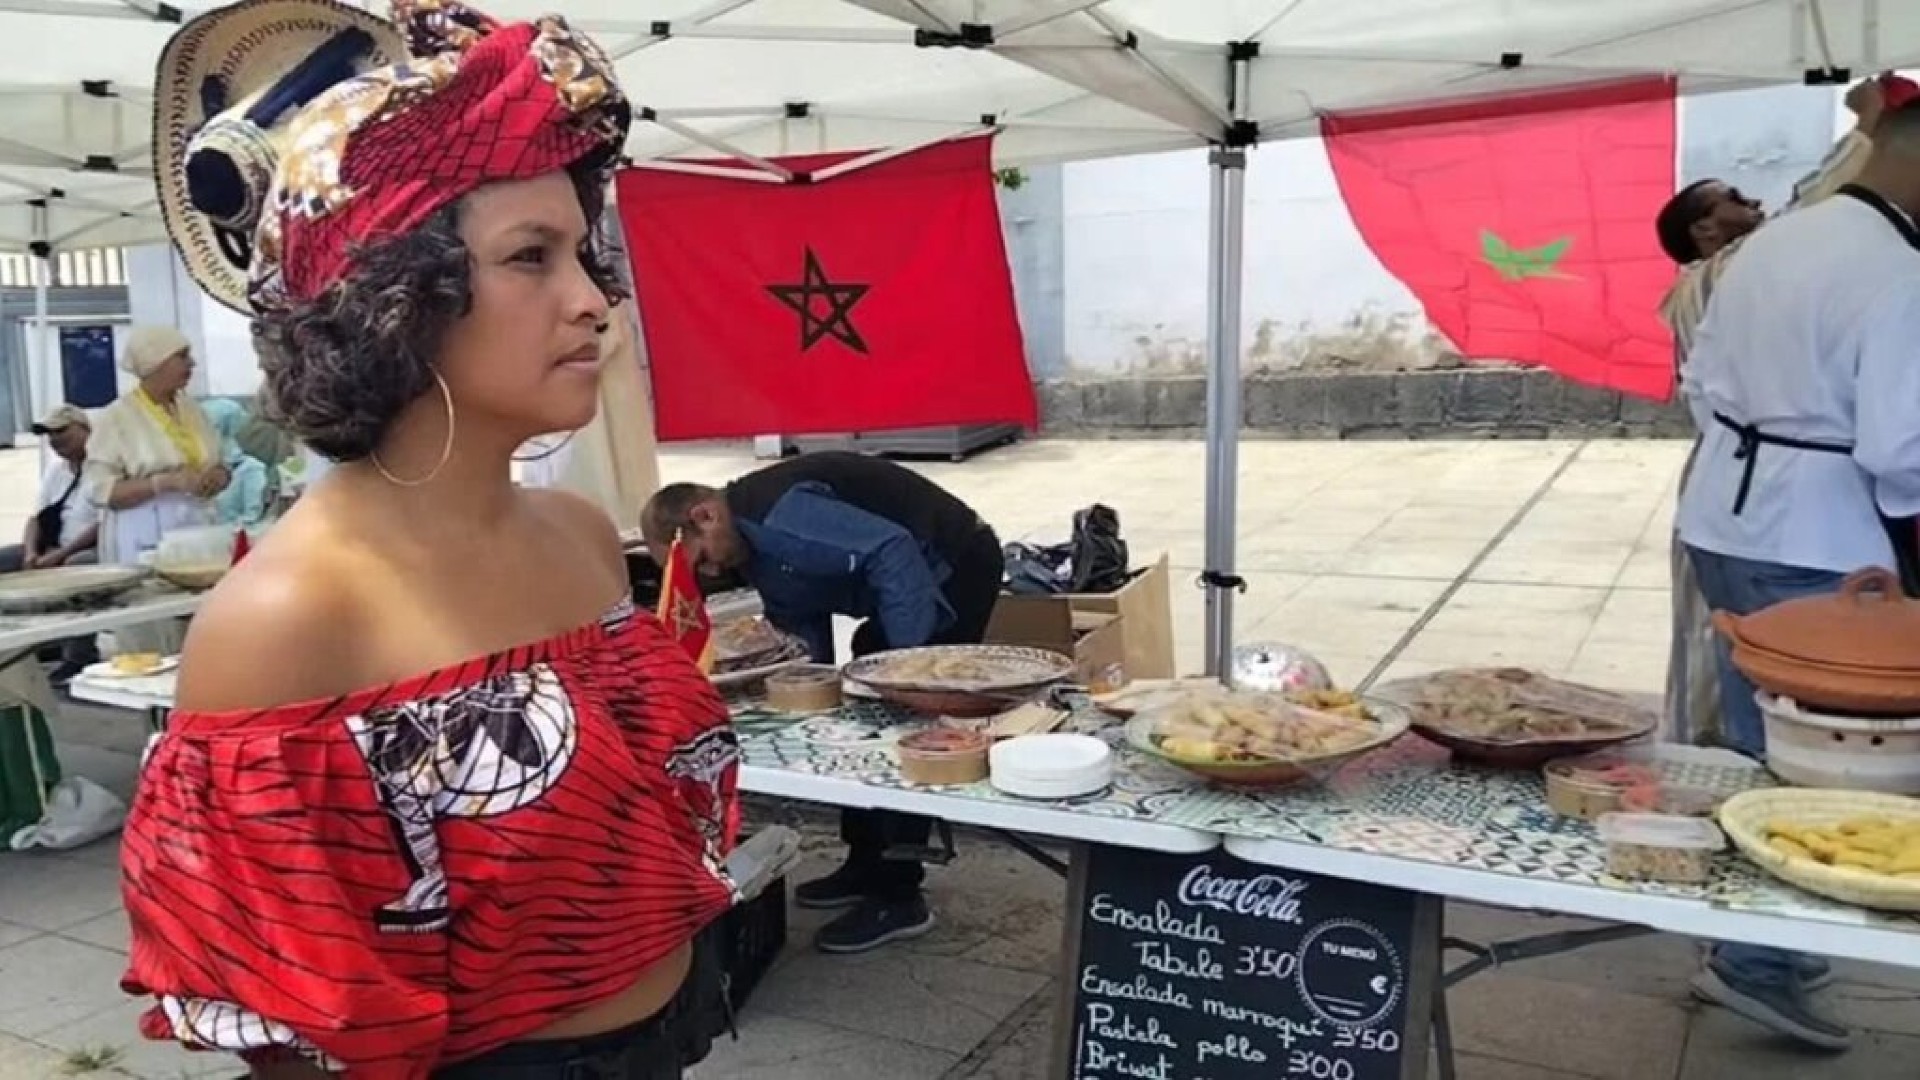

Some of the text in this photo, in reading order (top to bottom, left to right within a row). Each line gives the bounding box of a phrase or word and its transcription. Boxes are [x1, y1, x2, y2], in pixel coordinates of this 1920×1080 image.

[1089, 893, 1226, 945] Ensalada
[1131, 941, 1225, 981] Tabule
[1322, 941, 1339, 955] TU
[1080, 964, 1193, 1010] Ensalada
[1085, 1002, 1179, 1049] Pastela
[1197, 1033, 1267, 1063] pollo
[1084, 1039, 1175, 1080] Briwat
